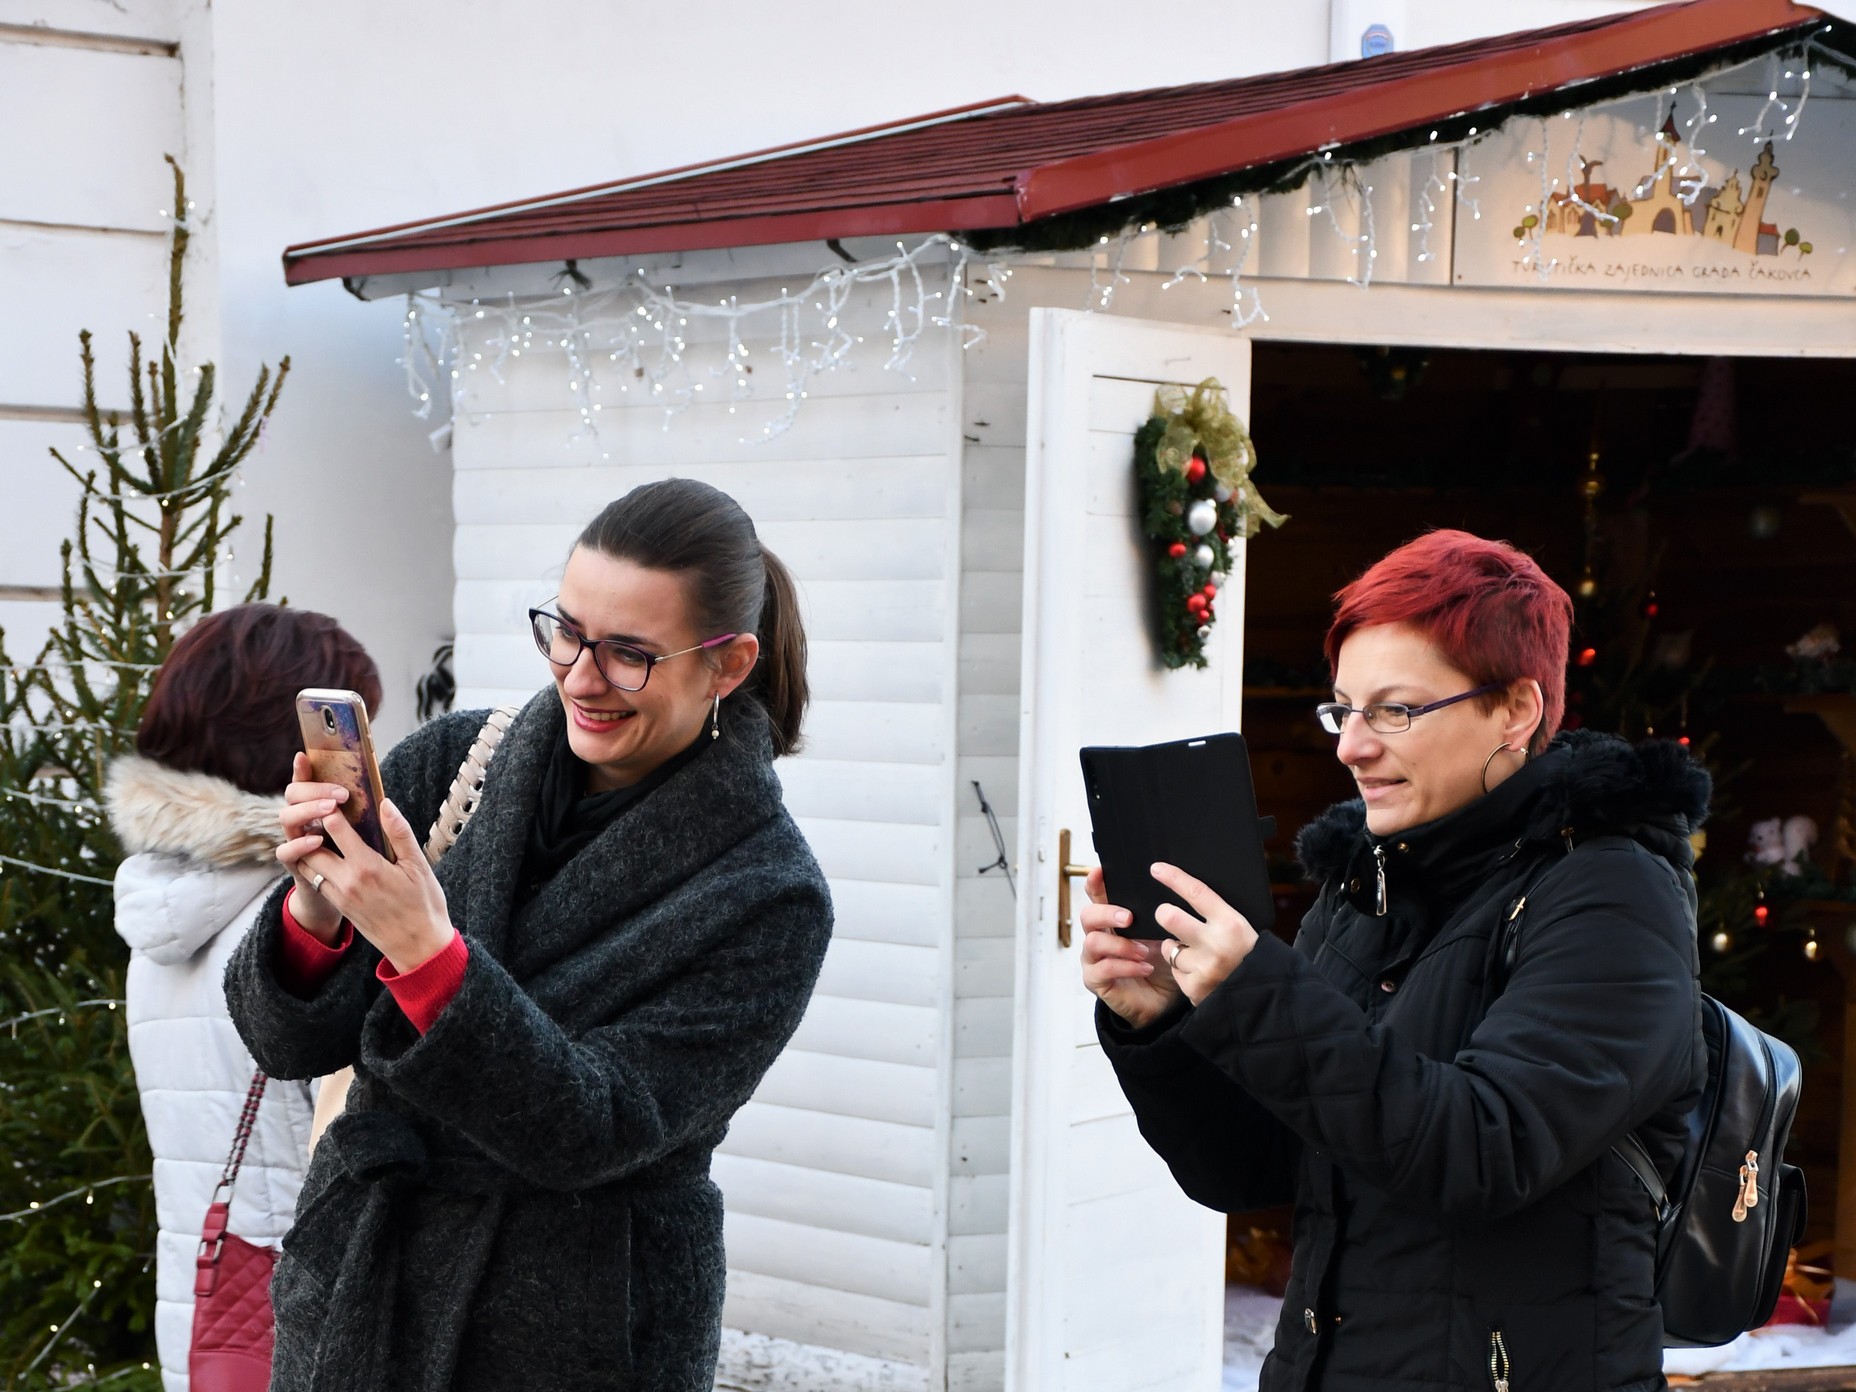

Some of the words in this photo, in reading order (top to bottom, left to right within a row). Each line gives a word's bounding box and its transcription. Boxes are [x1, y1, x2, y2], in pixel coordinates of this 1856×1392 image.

[1512, 254, 1596, 275] TURTIČKA
[1604, 263, 1684, 282] ZAJEDNICA
[1692, 264, 1741, 278] GRADA
[1749, 260, 1812, 280] ČAKOVCA
